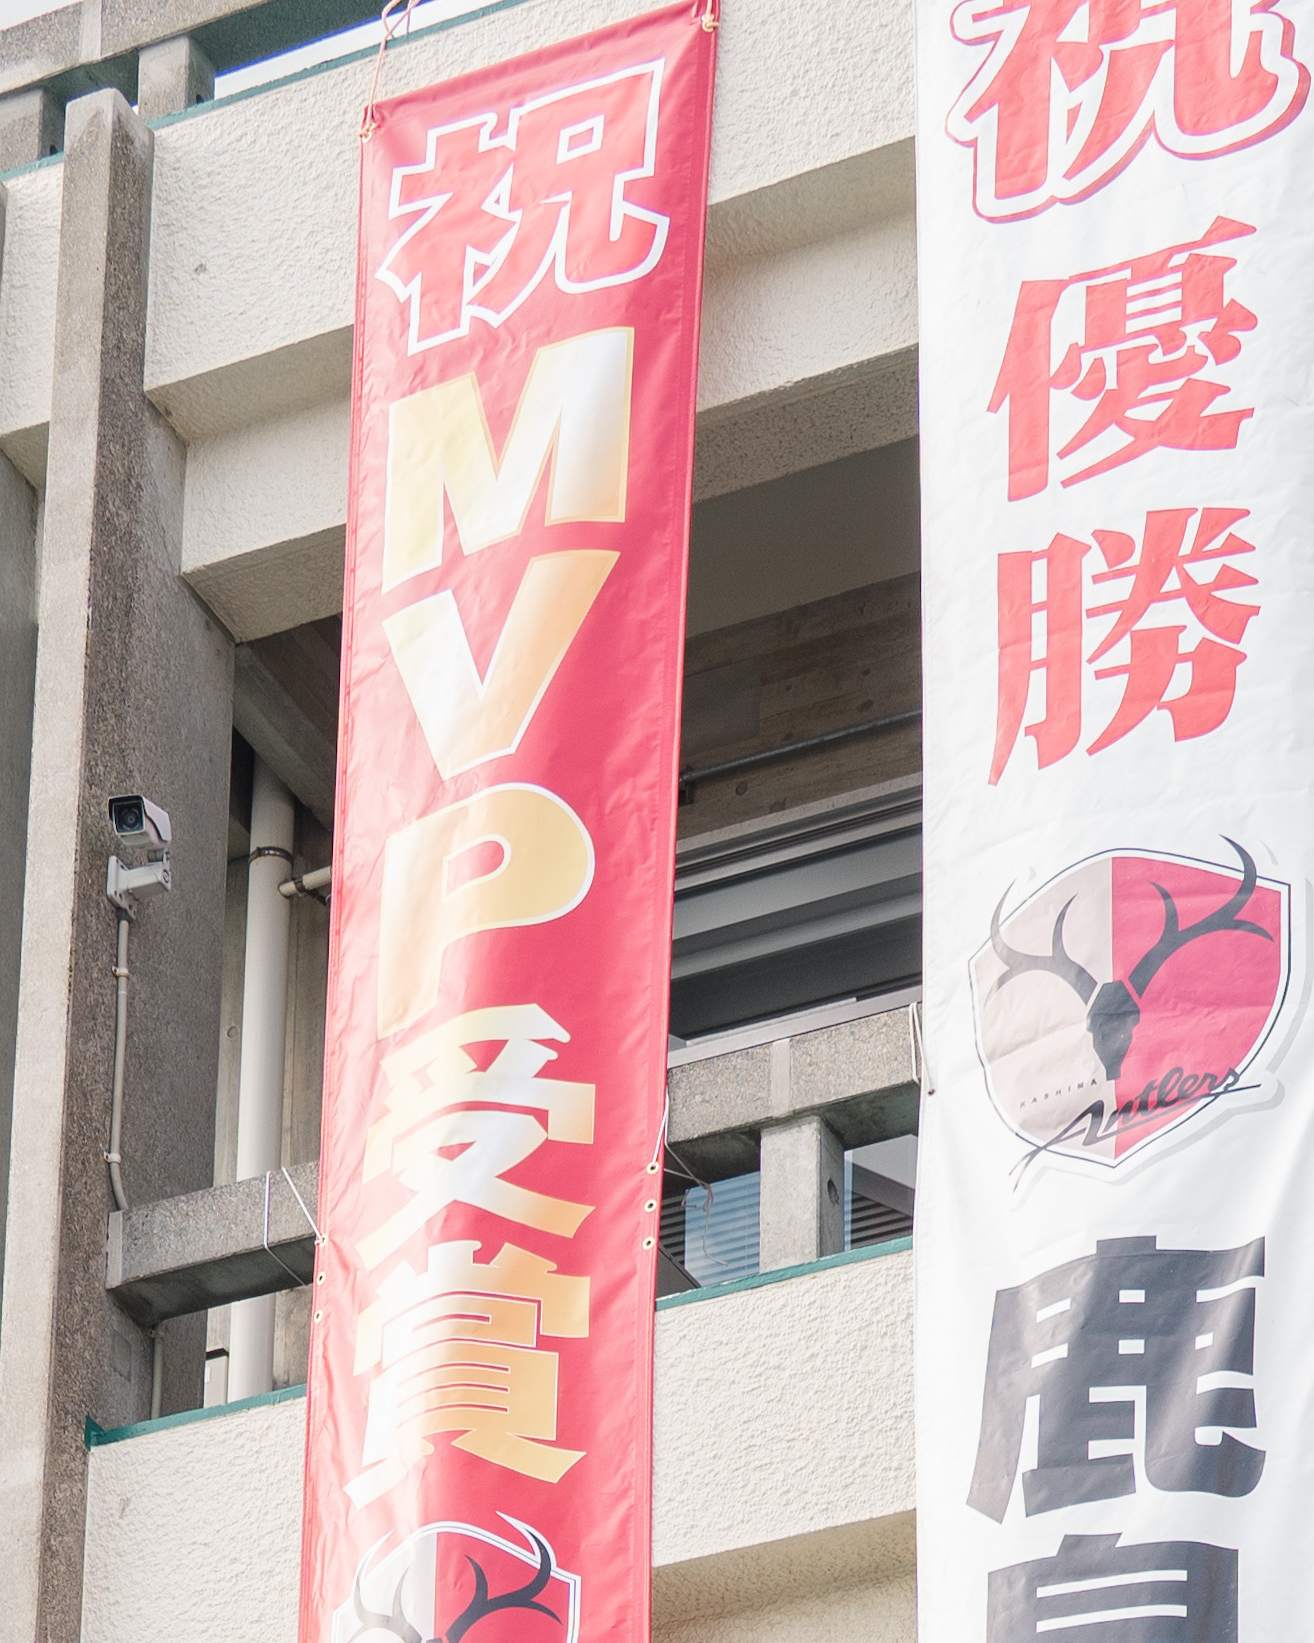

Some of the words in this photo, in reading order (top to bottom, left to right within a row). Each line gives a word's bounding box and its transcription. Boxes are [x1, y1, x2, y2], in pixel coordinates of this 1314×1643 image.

[375, 56, 671, 356] 祝
[986, 216, 1262, 786] 優勝
[1009, 1067, 1261, 1193] Antlers
[1019, 1078, 1098, 1109] KASHIMA
